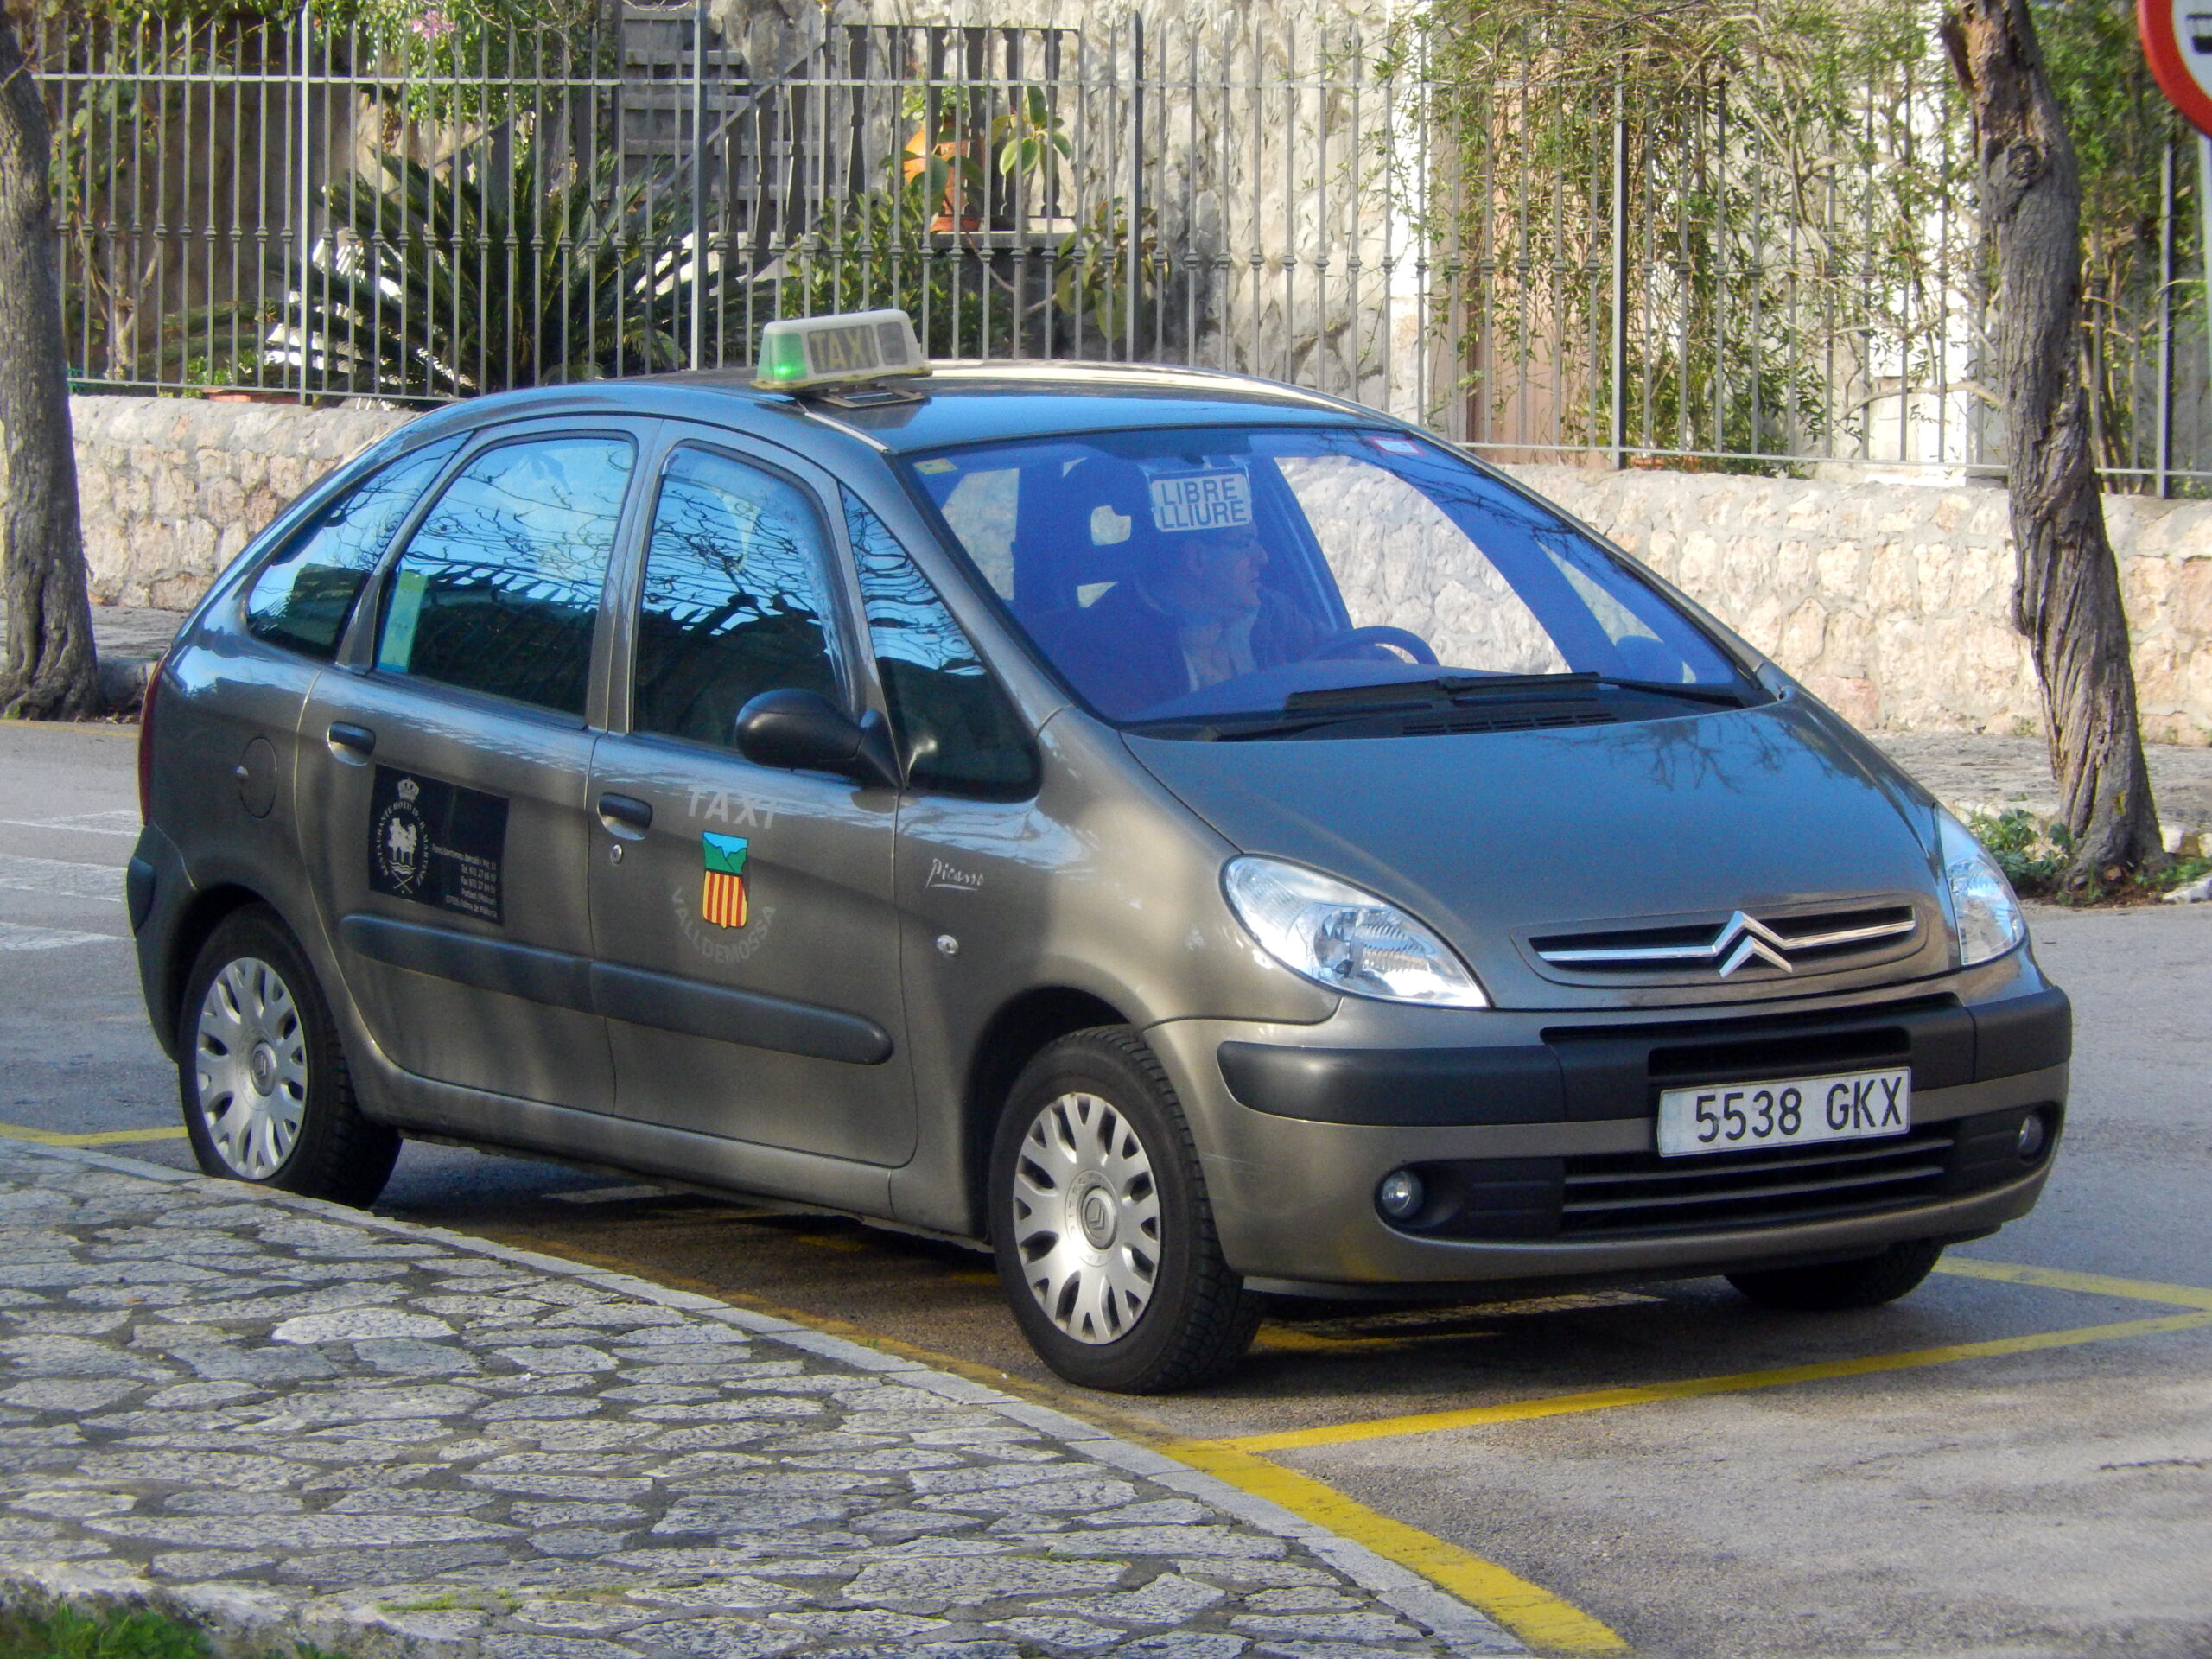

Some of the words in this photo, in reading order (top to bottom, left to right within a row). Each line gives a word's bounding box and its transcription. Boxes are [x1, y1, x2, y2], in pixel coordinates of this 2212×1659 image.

[809, 325, 877, 372] TAXI
[1161, 478, 1237, 505] LIBRE
[1160, 500, 1247, 528] LLIURE
[687, 785, 778, 829] TAXI
[925, 858, 984, 889] Picasso
[671, 887, 776, 963] VALLDEMOSSA
[1696, 1087, 1802, 1143] 5538
[1826, 1077, 1903, 1131] GKX
